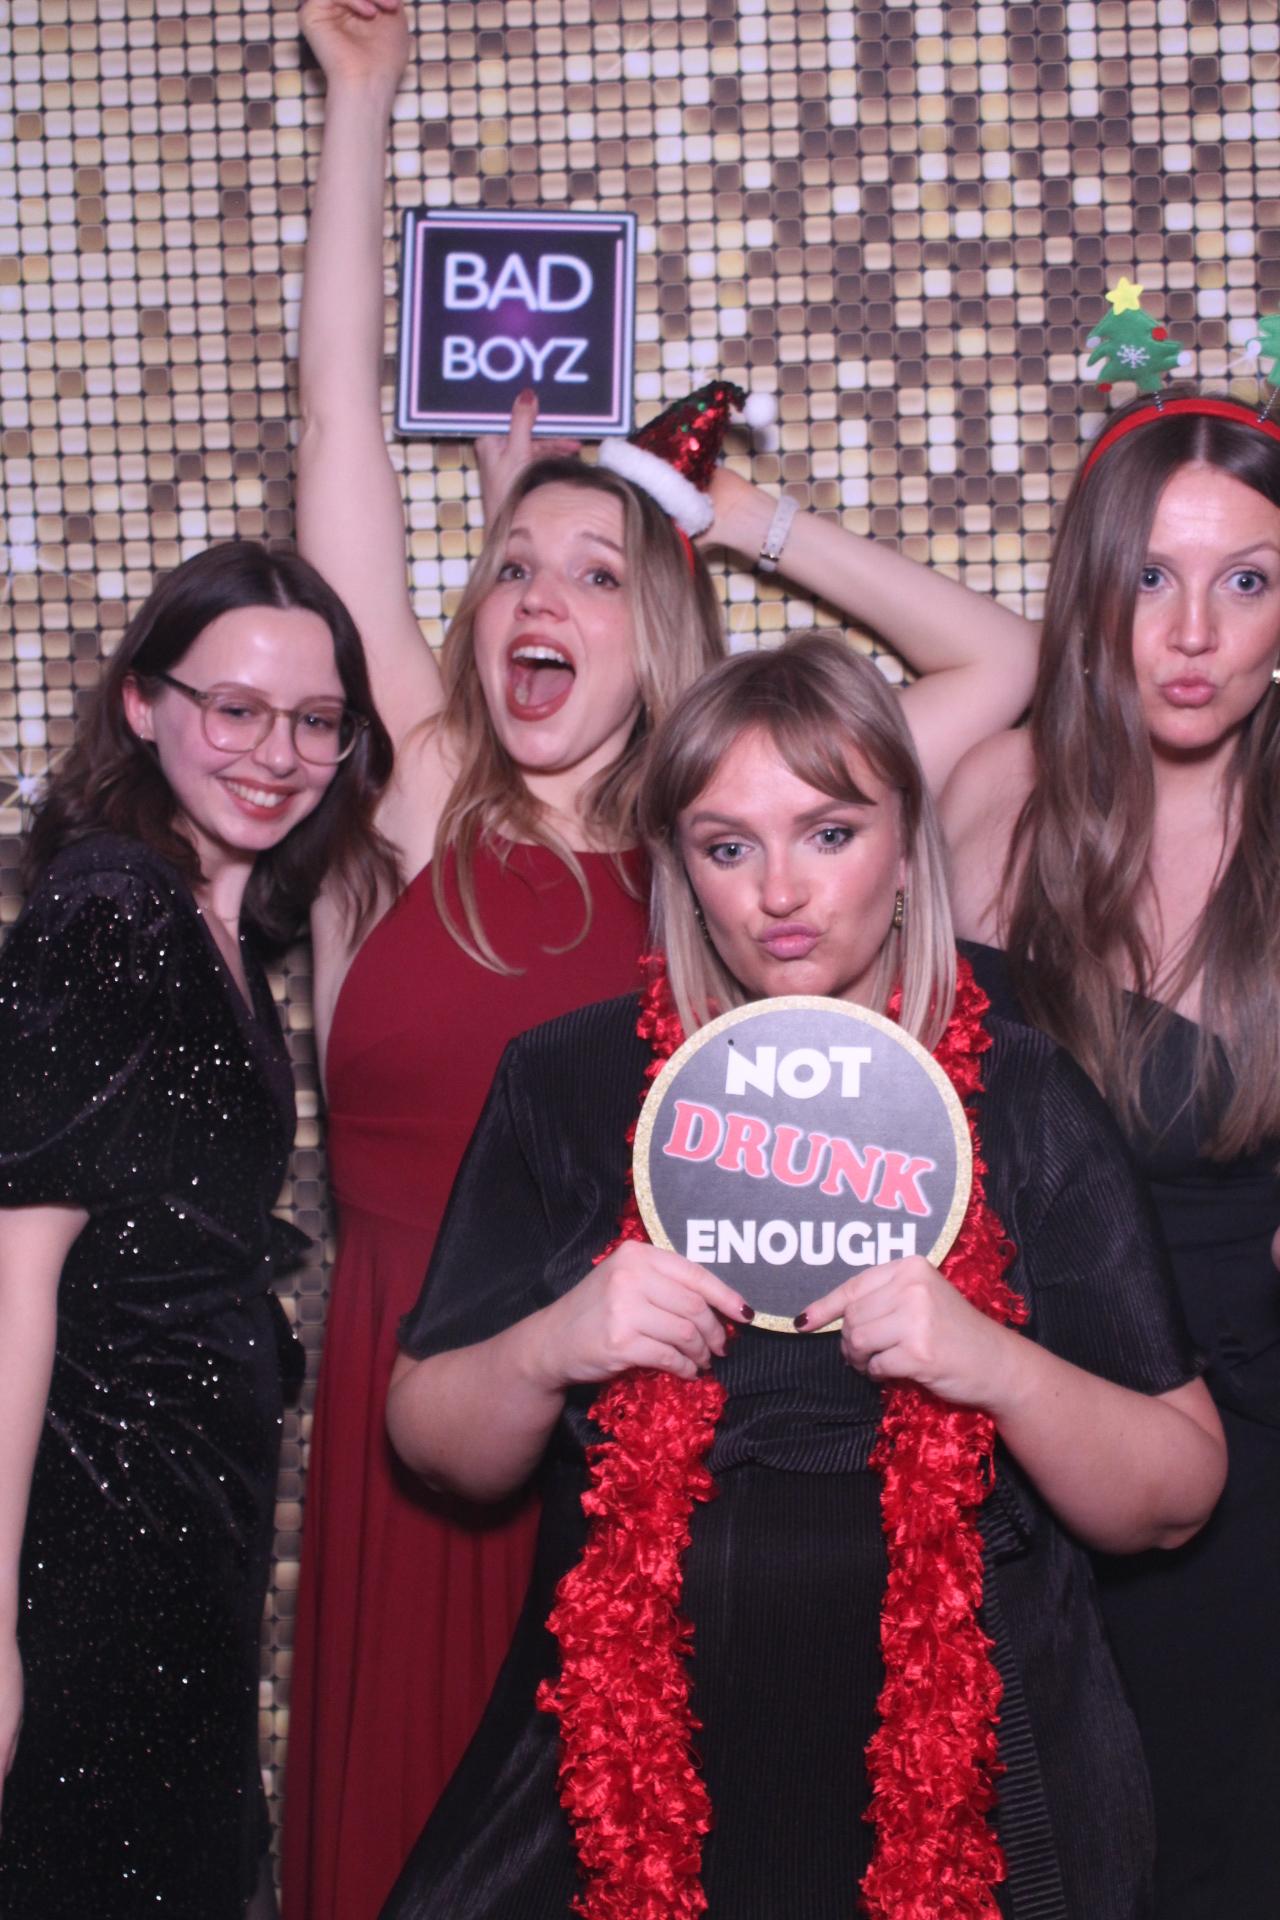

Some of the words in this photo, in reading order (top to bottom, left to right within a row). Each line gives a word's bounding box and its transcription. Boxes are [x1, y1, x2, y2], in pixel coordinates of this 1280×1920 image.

[444, 252, 593, 312] BAD
[442, 335, 589, 382] BOYZ
[725, 1046, 872, 1099] NOT
[663, 1100, 936, 1217] DRUNK
[686, 1219, 916, 1266] ENOUGH
